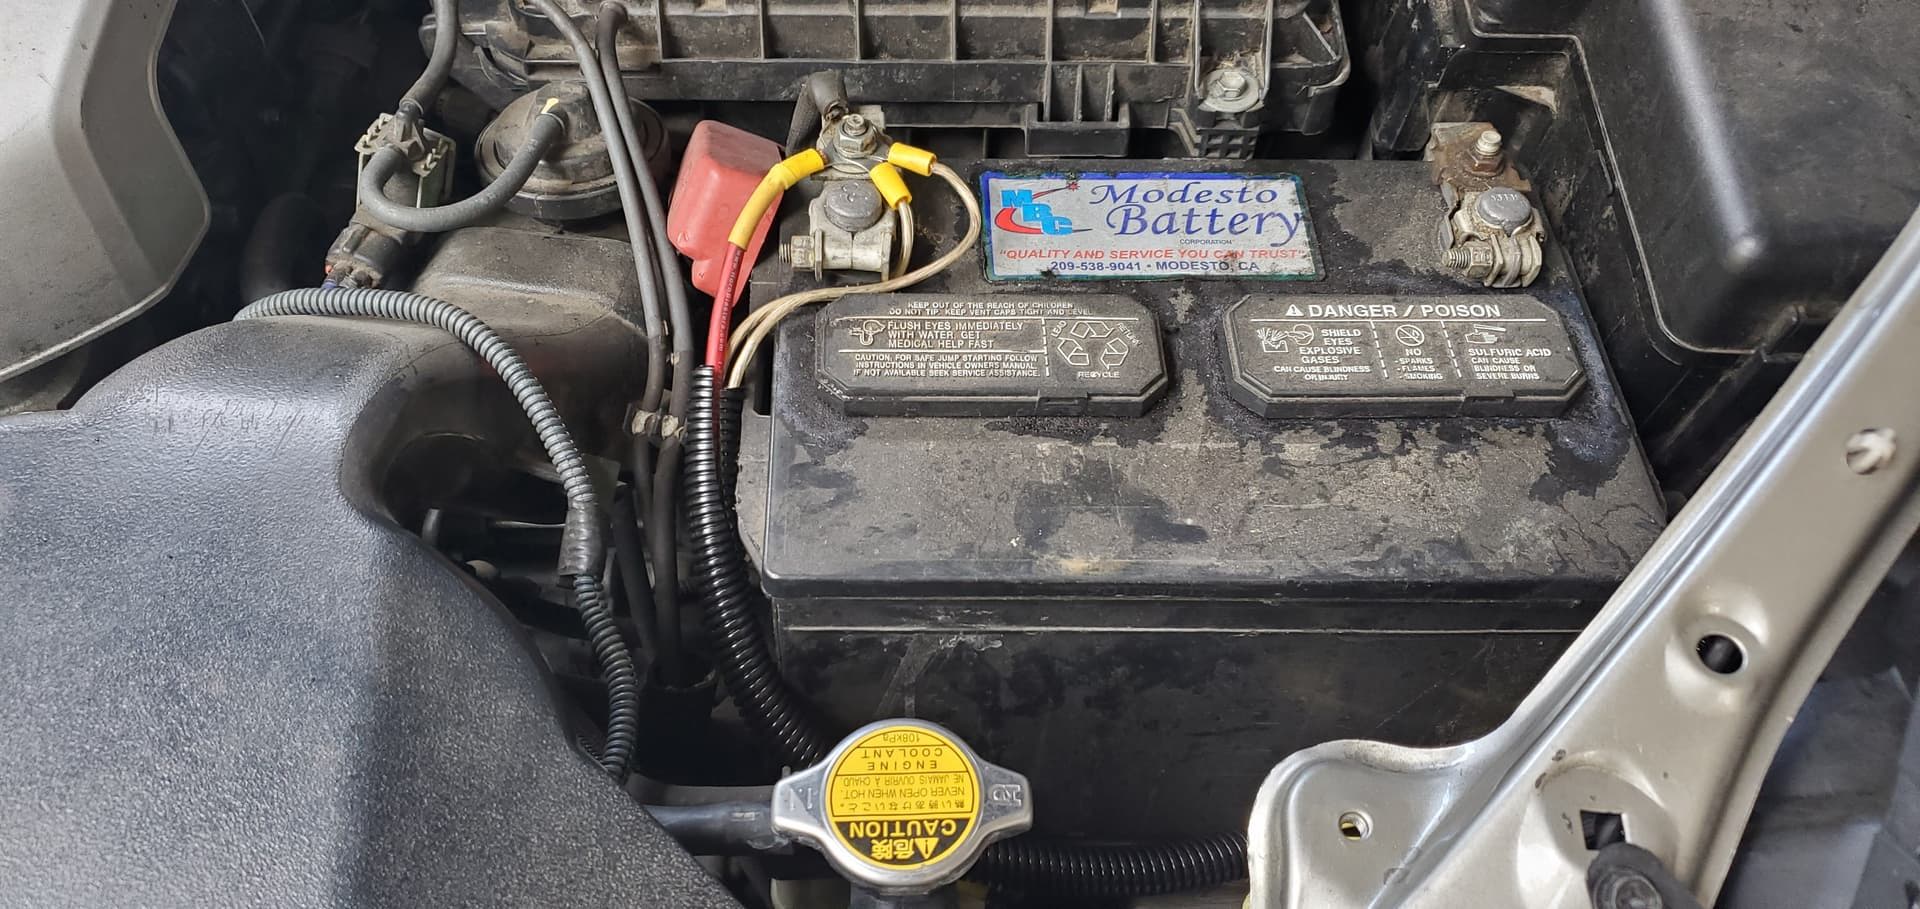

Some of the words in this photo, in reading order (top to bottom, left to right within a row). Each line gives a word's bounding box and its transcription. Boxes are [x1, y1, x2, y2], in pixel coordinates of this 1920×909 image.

[1089, 181, 1278, 205] Modesto
[1106, 203, 1303, 247] Battery
[1073, 249, 1105, 259] AND
[1109, 249, 1173, 259] SERVICE
[1178, 249, 1208, 259] YOU
[1213, 249, 1244, 259] CAN
[1050, 261, 1141, 271] 209-538-9041
[1238, 261, 1260, 271] CA
[1308, 305, 1398, 317] DANGER
[1420, 305, 1502, 317] POISON
[887, 321, 921, 330] FLUSH
[924, 321, 951, 330] EYES
[955, 321, 1023, 330] IMMEDIATELY
[1050, 320, 1068, 338] LEAD
[887, 331, 914, 339] WITH
[960, 331, 981, 339] GET
[1321, 328, 1362, 337] SHIELD
[888, 339, 934, 348] MEDICAL
[938, 339, 964, 348] HELP
[1323, 338, 1353, 346] EYES
[1299, 346, 1362, 355] EXPLOSIVE
[1405, 348, 1422, 356] NO
[1468, 348, 1523, 357] SULFURIC
[1525, 348, 1552, 357] ACID
[1301, 356, 1340, 364] GASES
[1471, 357, 1489, 365] CAN
[1492, 357, 1521, 365] CAUSE
[1273, 365, 1292, 373] CAN
[1293, 365, 1322, 373] CAUSE
[1323, 365, 1371, 373] BLINDNESS
[1077, 371, 1121, 379] RECYCLE
[883, 732, 921, 743] 108kPa
[862, 747, 943, 759] COOLANT
[867, 760, 938, 771] ENGINE
[884, 775, 915, 786] OUVRIR
[919, 774, 950, 785] JAMAIS
[953, 773, 965, 782] NE
[840, 789, 866, 800] HOT.
[868, 788, 897, 799] WHEN
[899, 787, 928, 798] OPEN
[930, 786, 965, 797] NEVER
[849, 819, 957, 839] CAUTION
[871, 837, 916, 861] 危険
